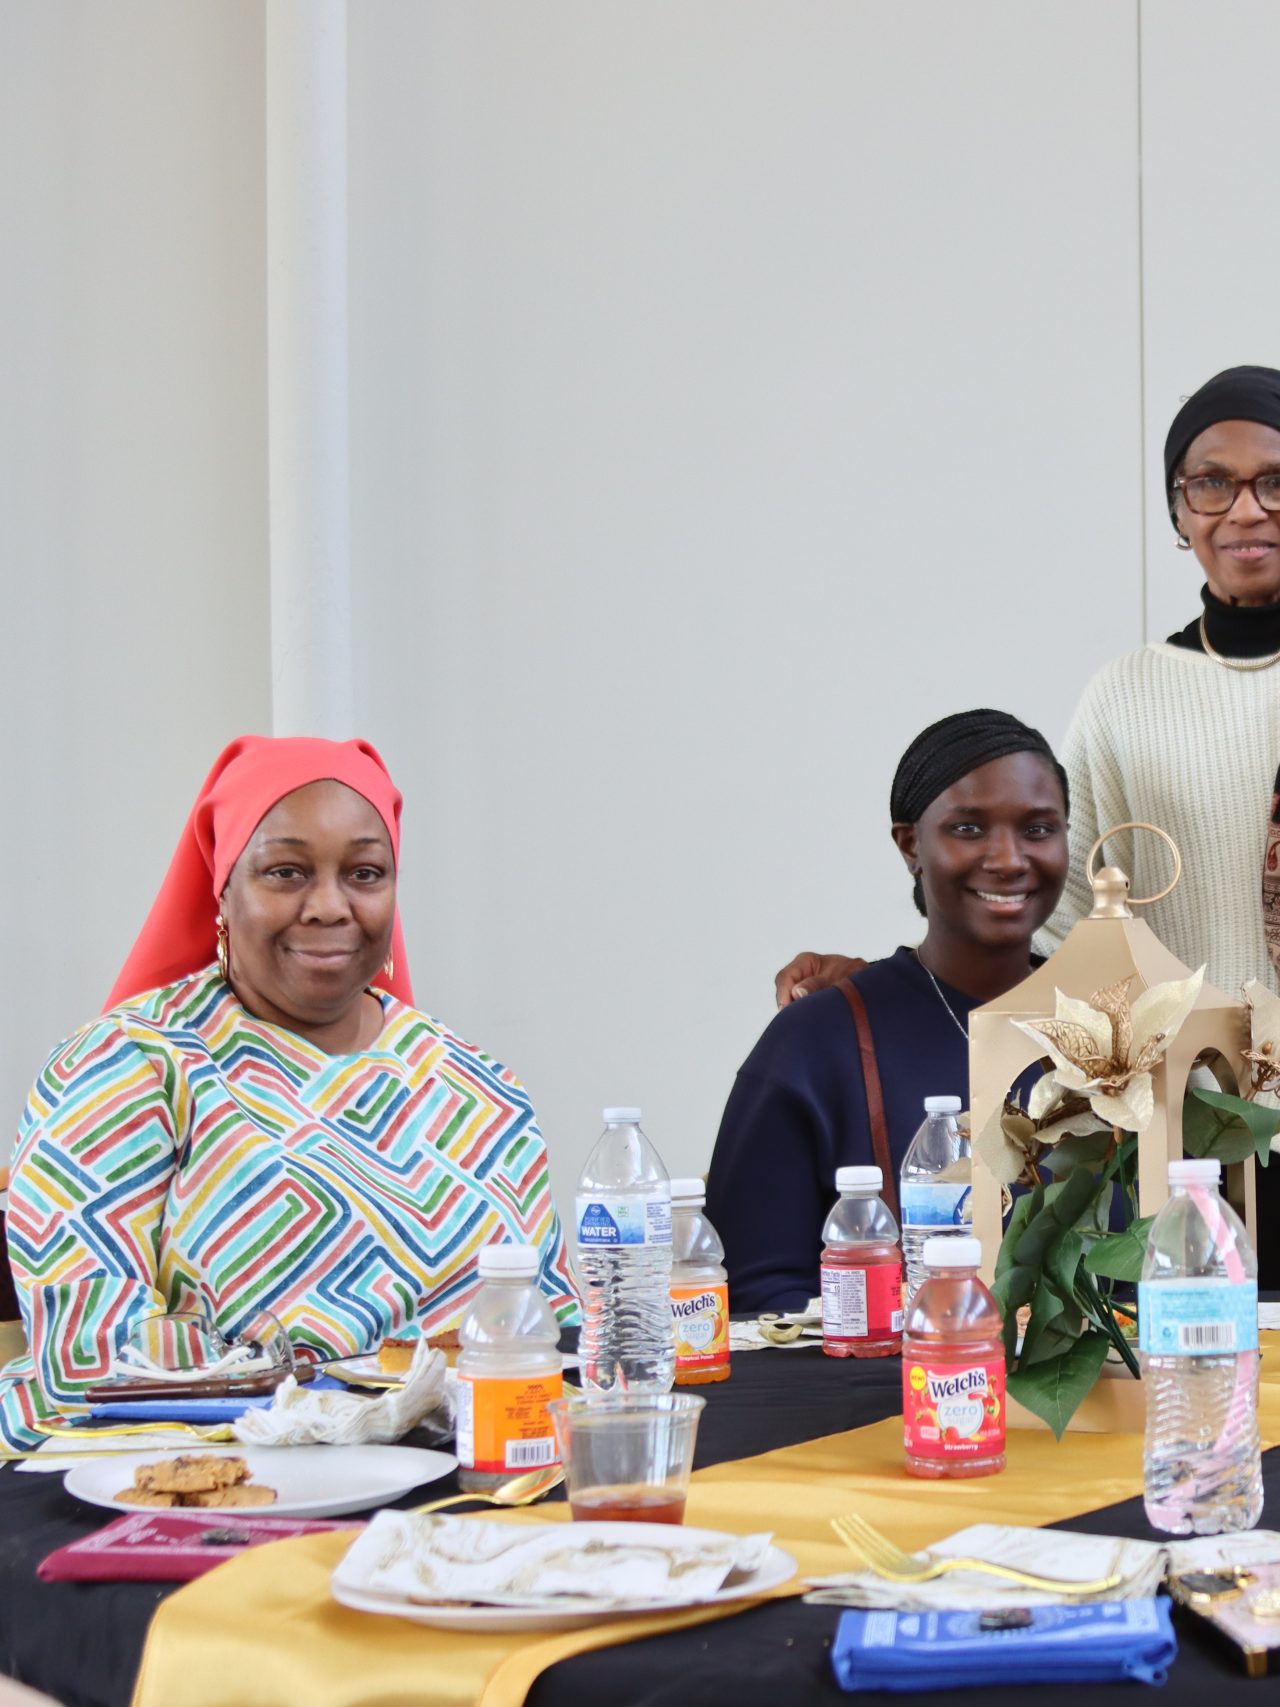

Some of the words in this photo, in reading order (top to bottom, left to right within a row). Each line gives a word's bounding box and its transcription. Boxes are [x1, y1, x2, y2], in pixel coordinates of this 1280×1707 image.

[581, 1226, 617, 1237] WATER
[670, 1293, 716, 1318] Welch's
[682, 1322, 711, 1333] zero
[931, 1370, 985, 1398] Welch's
[944, 1405, 978, 1417] zero
[944, 1443, 979, 1451] Strawberry
